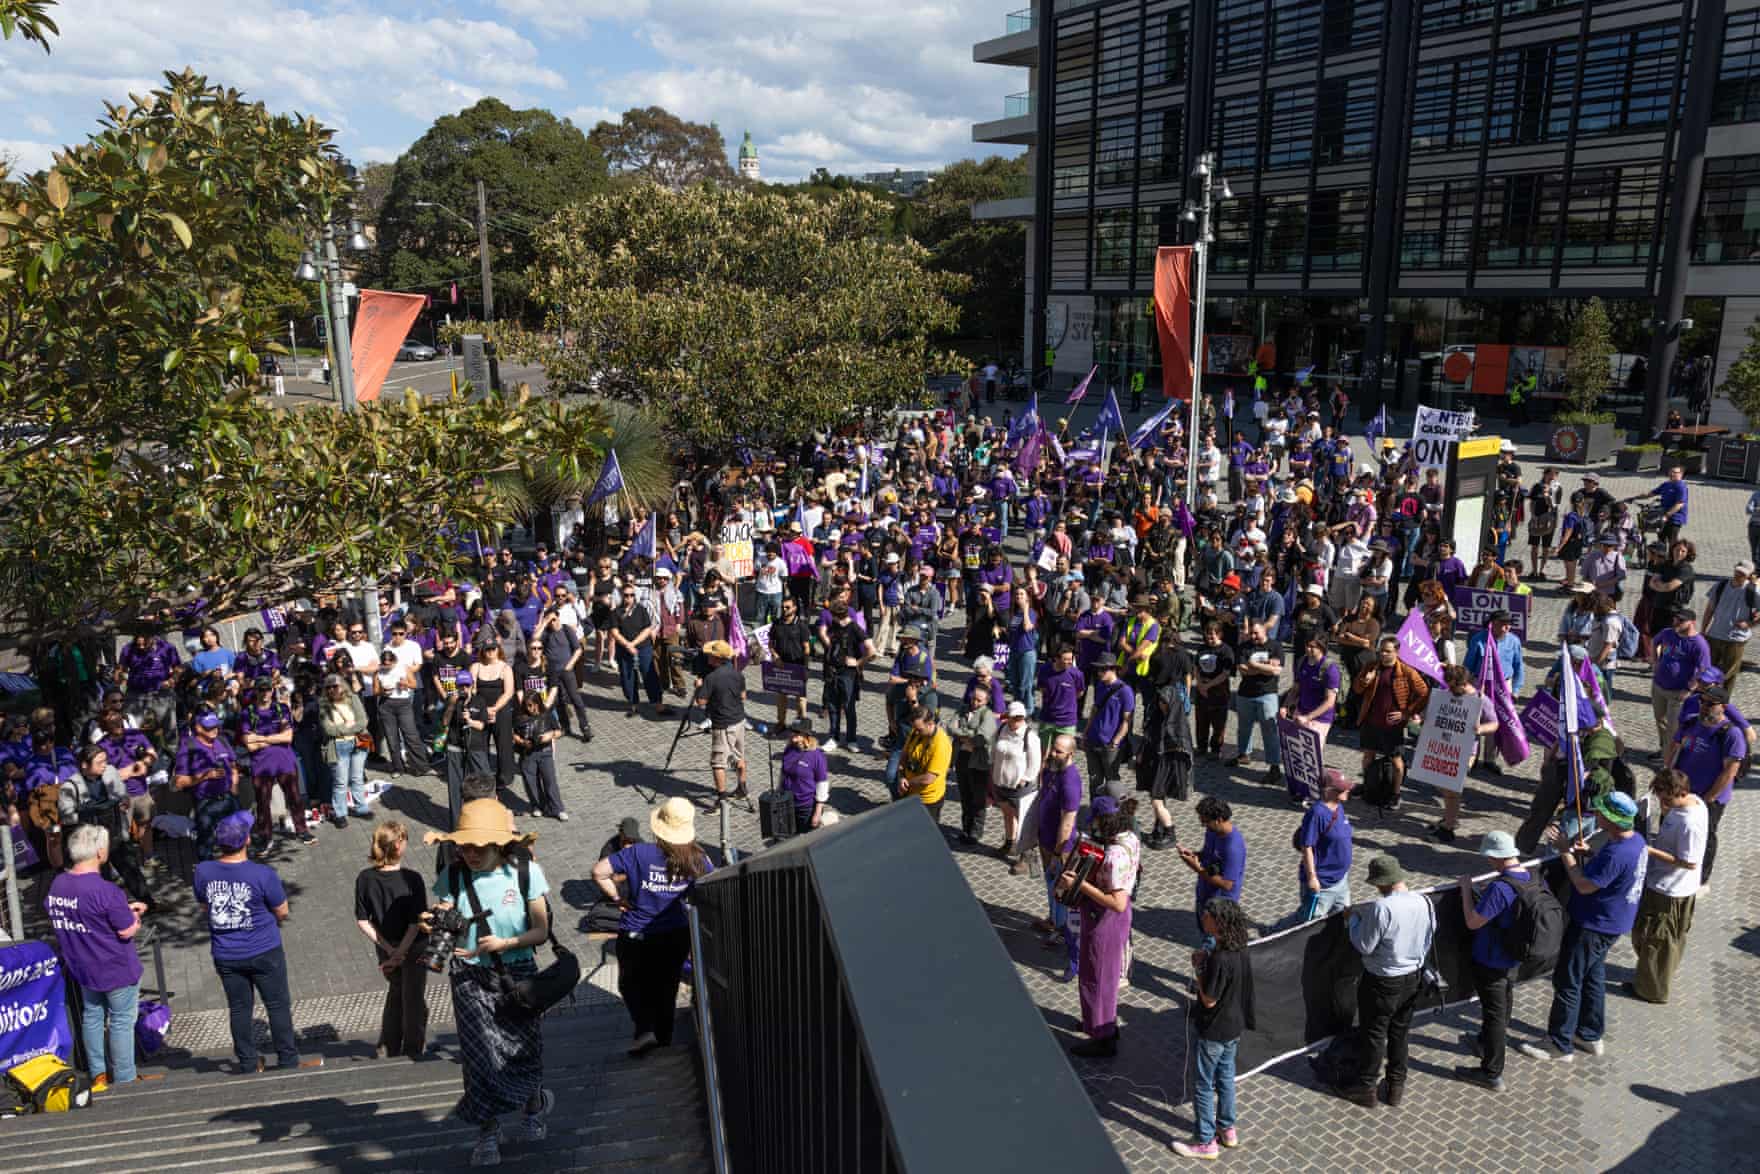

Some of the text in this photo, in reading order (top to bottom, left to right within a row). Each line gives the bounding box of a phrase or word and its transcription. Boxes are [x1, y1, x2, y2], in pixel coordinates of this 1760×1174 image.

[720, 523, 753, 544] BLACK
[1476, 594, 1503, 608] ON
[1461, 608, 1522, 627] STRE
[1438, 703, 1469, 721] HUMAN
[1434, 715, 1467, 734] BEINGS
[1426, 738, 1462, 761] HUMAN
[1288, 740, 1307, 781] LINE
[1420, 754, 1460, 778] RESOURCES
